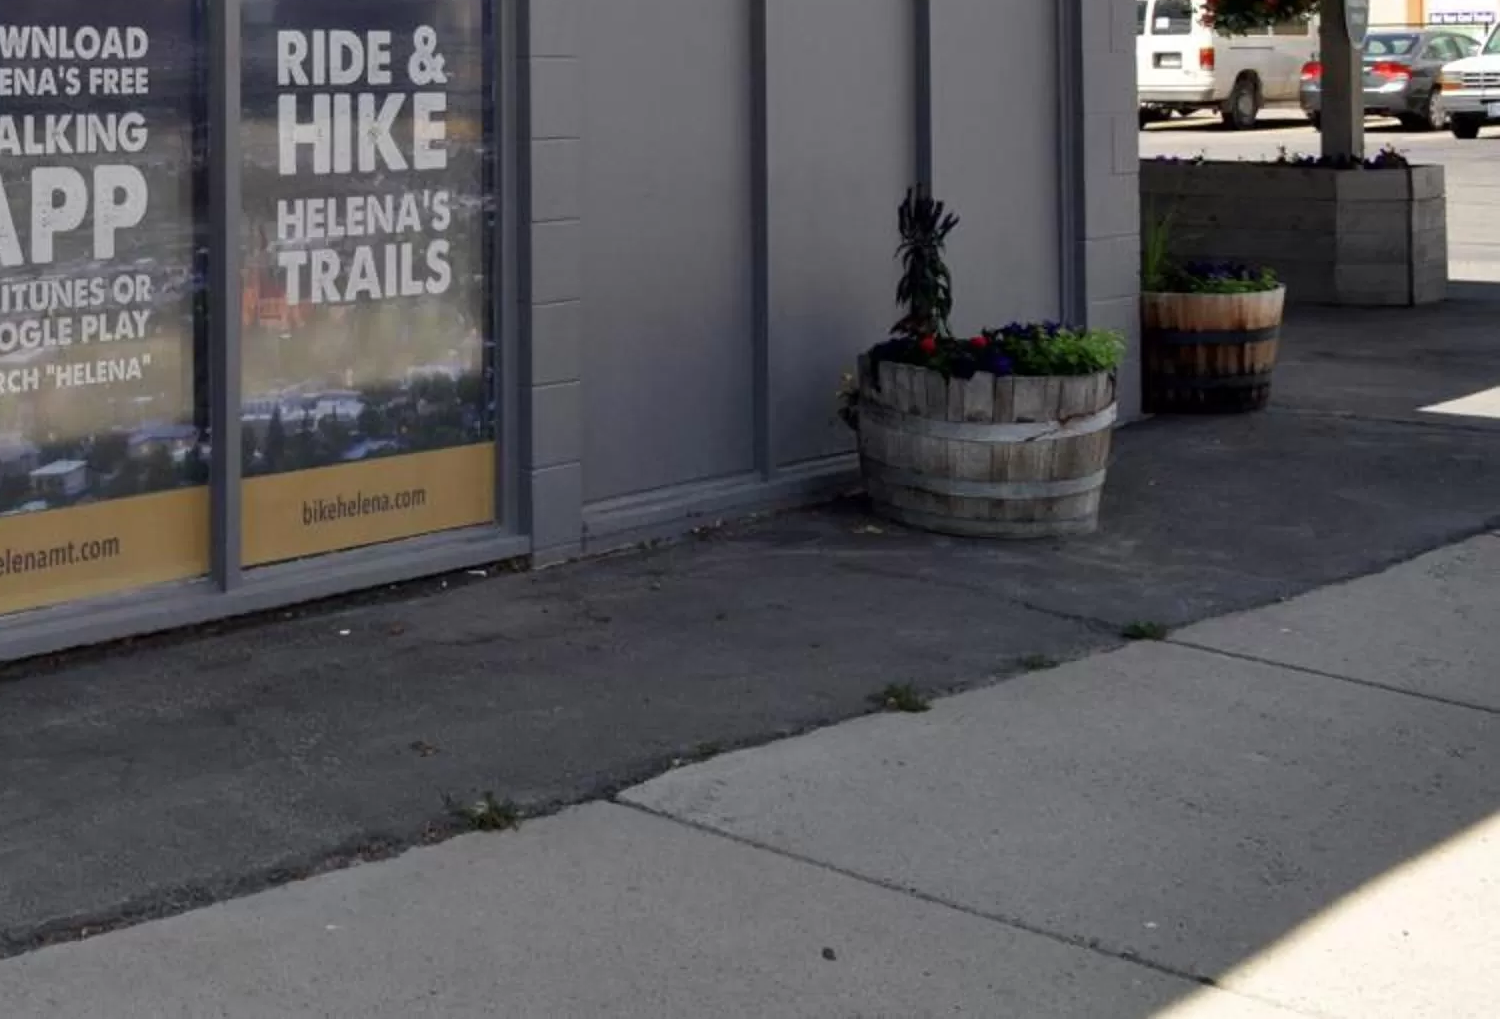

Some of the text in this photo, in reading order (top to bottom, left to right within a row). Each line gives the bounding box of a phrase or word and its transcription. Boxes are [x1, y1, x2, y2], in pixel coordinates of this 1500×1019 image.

[277, 25, 448, 86] RIDE &
[89, 67, 149, 95] FREE
[277, 92, 448, 175] HIKE
[277, 188, 450, 241] HELENA'S
[277, 239, 452, 305] TRAILS
[2, 278, 106, 314] ITUNES
[113, 274, 152, 304] OR
[81, 309, 151, 343] PLAY
[46, 353, 152, 388] "HELENA"
[303, 488, 427, 526] bikehelena.com
